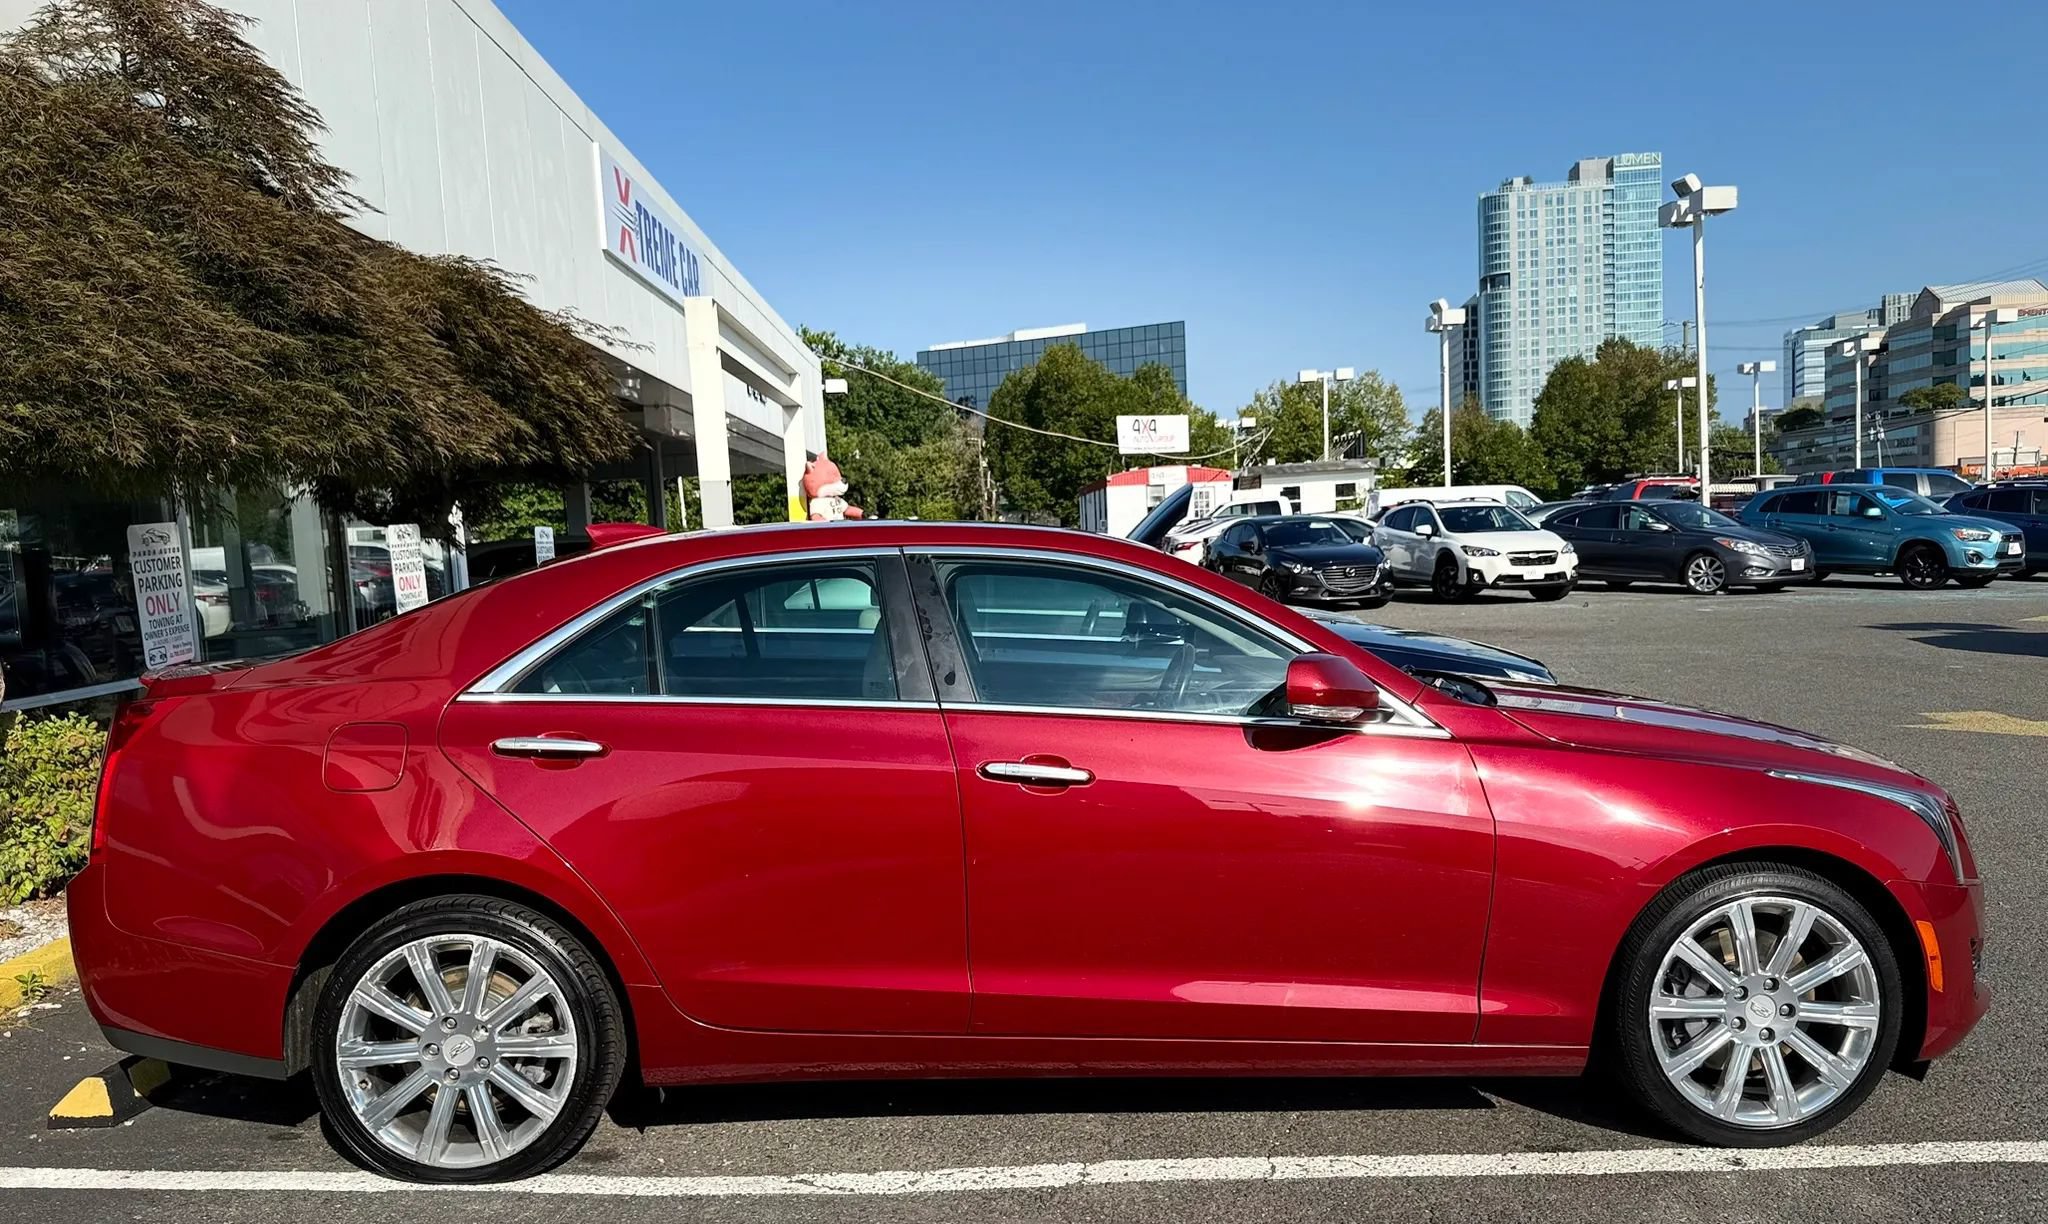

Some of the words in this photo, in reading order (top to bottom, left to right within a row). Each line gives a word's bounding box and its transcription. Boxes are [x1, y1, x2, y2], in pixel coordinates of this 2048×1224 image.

[1615, 152, 1662, 166] LUMEN
[392, 548, 421, 561] CUSTOMER
[133, 555, 182, 575] CUSTOMER
[394, 560, 422, 574] PARKING
[138, 572, 183, 594] PARKING
[398, 575, 421, 592] ONLY
[145, 592, 181, 617] ONLY
[148, 615, 175, 630] TOWING
[175, 614, 184, 625] AT
[144, 628, 169, 641] OWNER'S
[168, 624, 191, 637] EXPENSE
